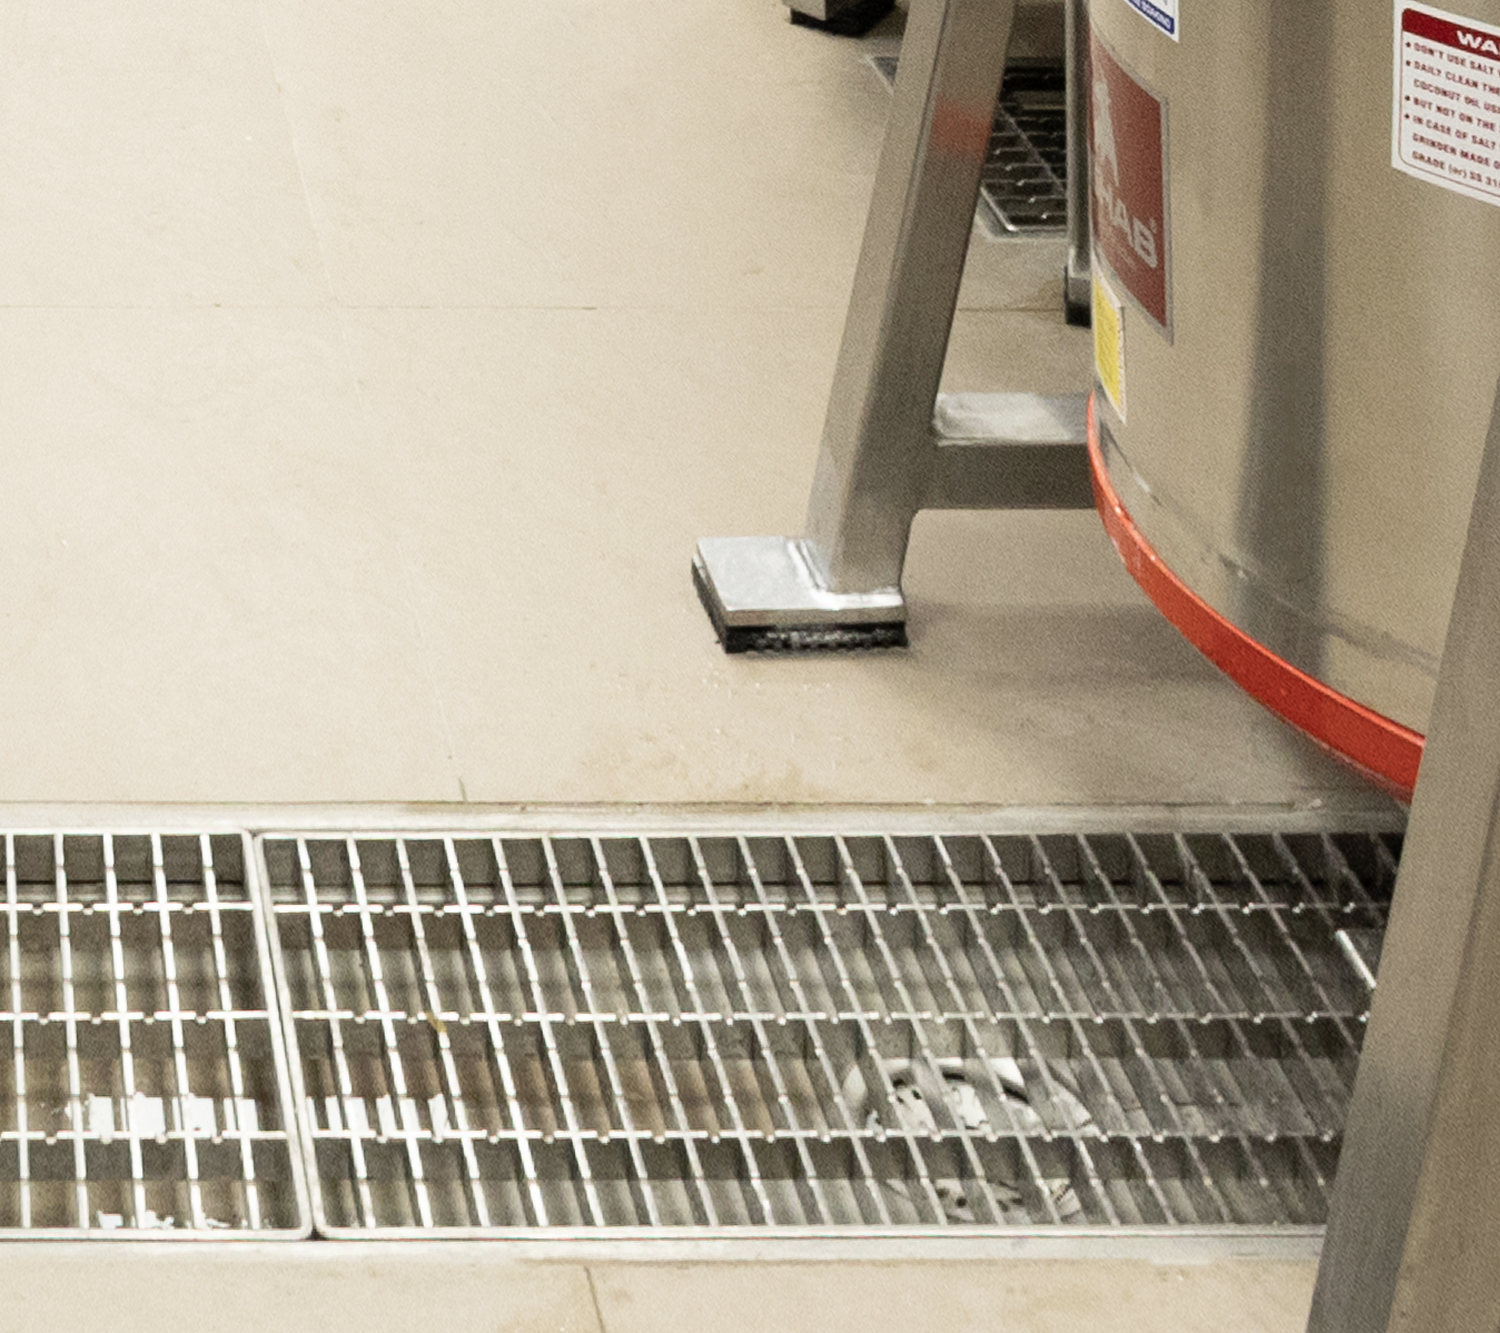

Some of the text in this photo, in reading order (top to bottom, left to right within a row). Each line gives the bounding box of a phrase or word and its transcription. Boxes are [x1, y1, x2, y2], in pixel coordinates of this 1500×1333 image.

[1447, 51, 1466, 66] USE
[1470, 58, 1494, 76] SALT
[1413, 78, 1461, 101] COCONUT
[1445, 71, 1478, 89] CLEAN
[1482, 82, 1500, 97] THE
[1413, 96, 1432, 111] BUT
[1436, 104, 1456, 119] NOT
[1458, 112, 1474, 124] ON
[1476, 118, 1496, 132] THE
[1413, 115, 1424, 126] IN
[1426, 119, 1451, 136] CASE
[1455, 131, 1468, 140] OF
[1471, 135, 1496, 152] SALT
[1412, 133, 1457, 155] GRINDER
[1460, 151, 1490, 167] MADE
